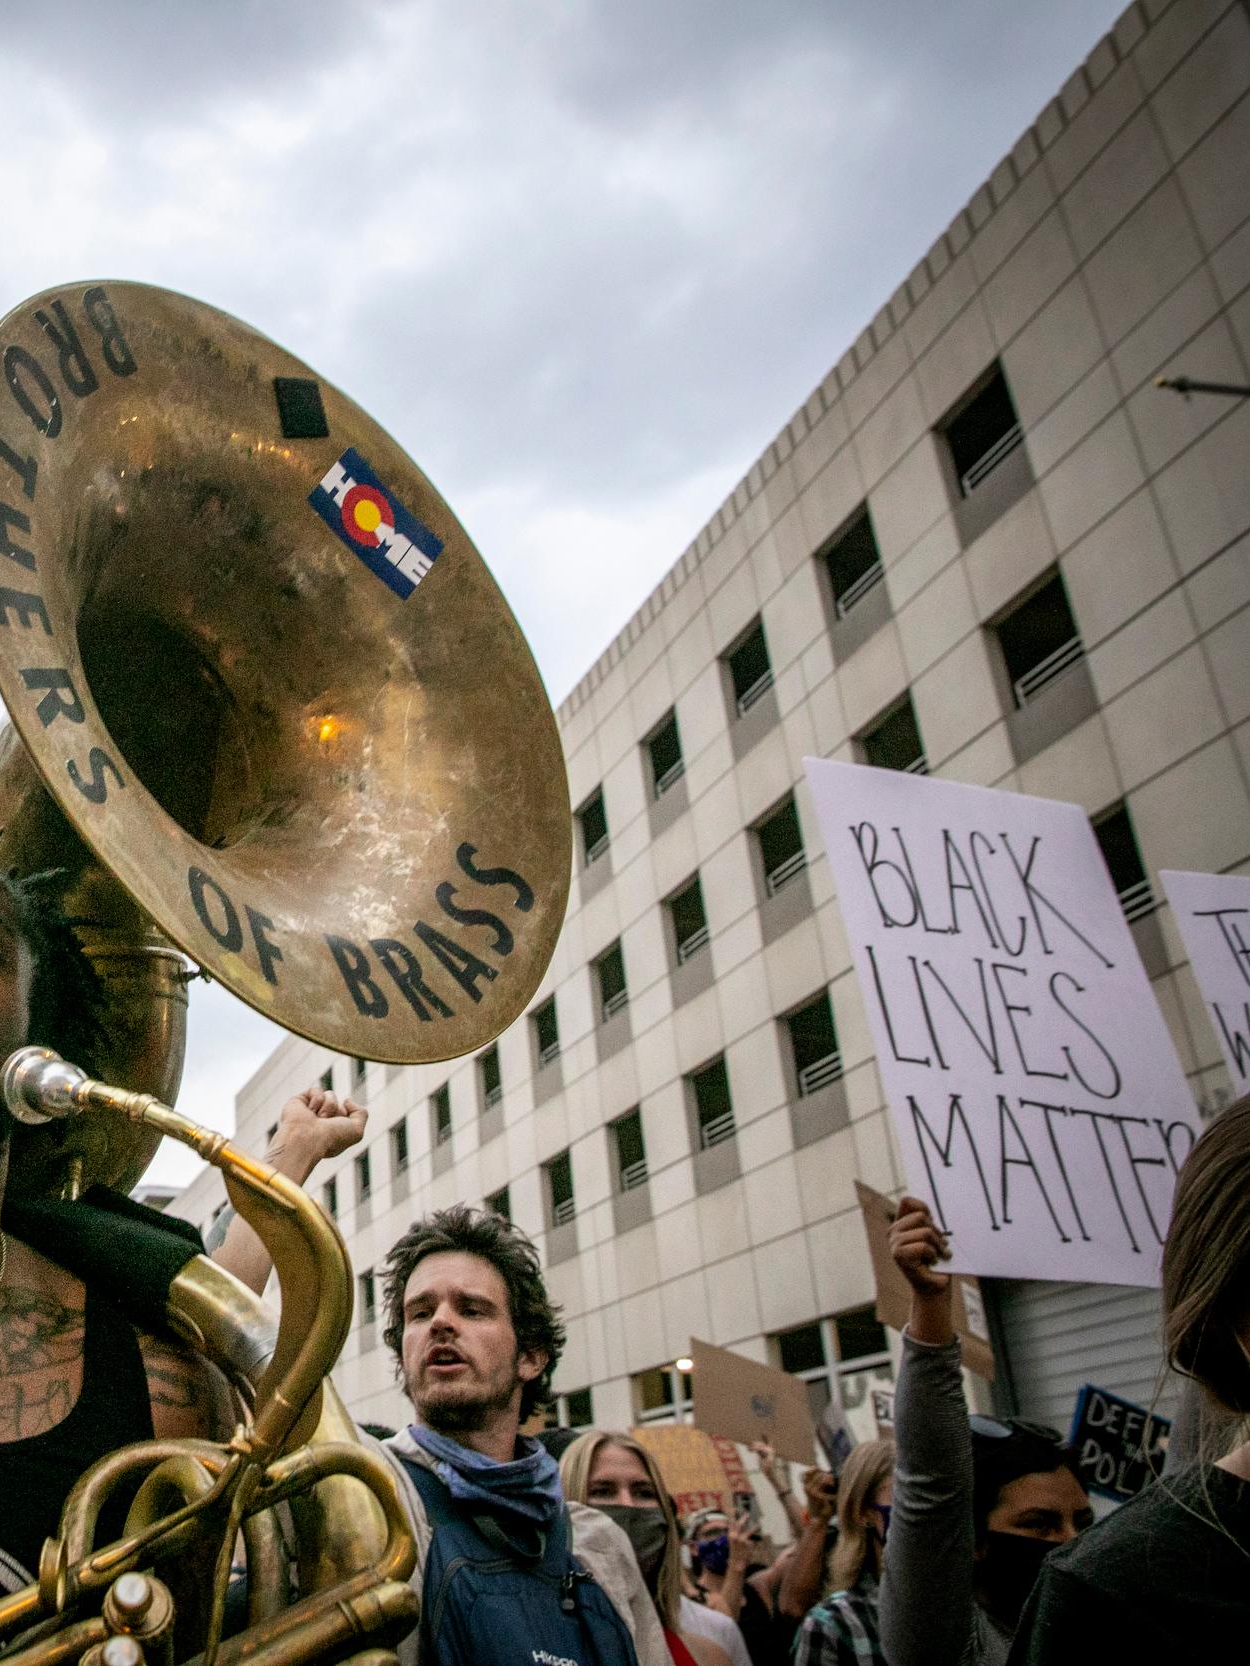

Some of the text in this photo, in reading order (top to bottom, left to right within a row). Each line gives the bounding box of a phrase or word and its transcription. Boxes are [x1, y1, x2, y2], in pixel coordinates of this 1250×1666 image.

[188, 865, 284, 986] OF
[323, 842, 535, 1022] BRASS
[849, 822, 1115, 968] BLACK
[865, 945, 1122, 1099] LIVES
